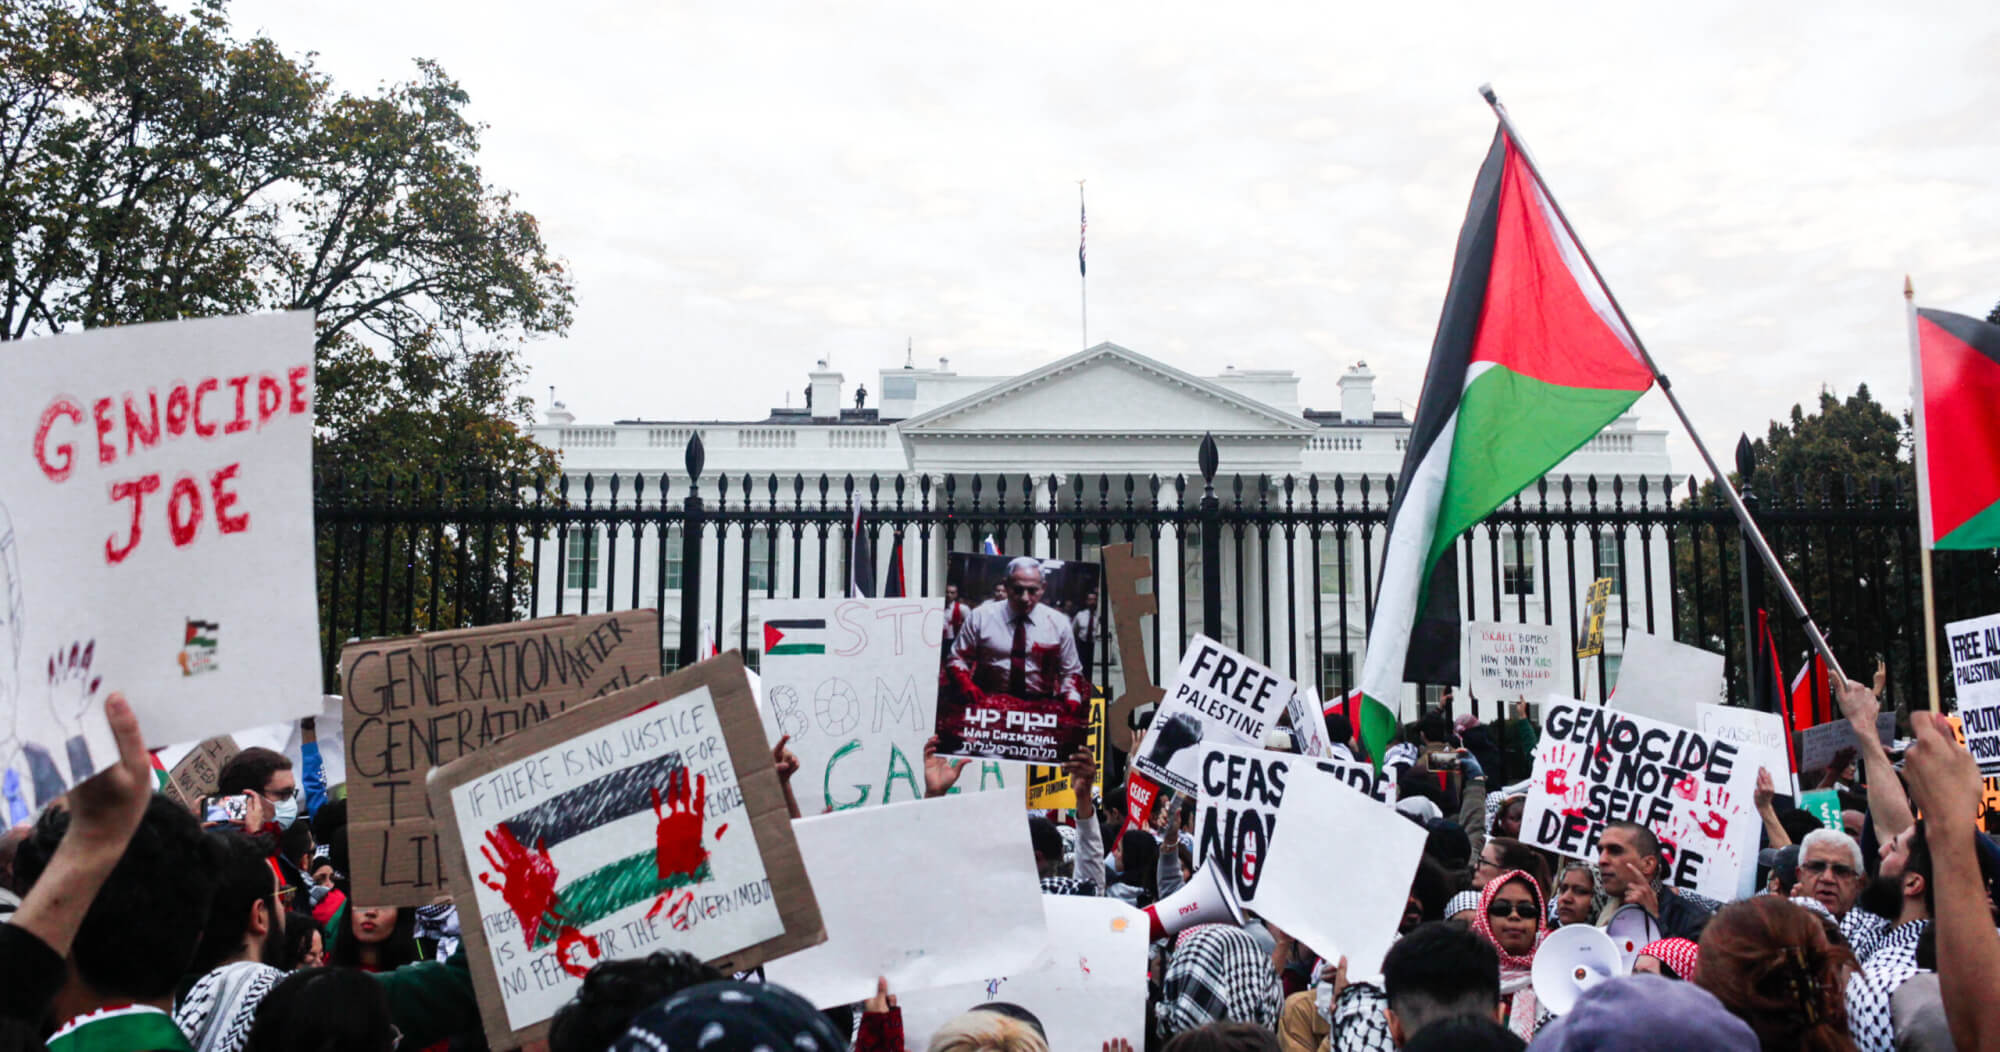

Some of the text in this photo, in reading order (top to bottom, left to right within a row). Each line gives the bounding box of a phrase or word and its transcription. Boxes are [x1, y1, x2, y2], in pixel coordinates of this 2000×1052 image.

[34, 366, 309, 482] GENOCIDE
[106, 463, 249, 564] JOE
[833, 601, 945, 657] STO
[1952, 631, 1983, 663] FREE
[348, 634, 567, 716] GENERATION
[566, 618, 632, 688] AFTER
[1189, 645, 1279, 714] FREE
[1481, 654, 1499, 665] HOW
[1504, 655, 1531, 666] MANY
[1176, 684, 1265, 740] PALESTINE
[468, 782, 486, 816] IF
[488, 757, 552, 810] THERE
[562, 750, 584, 776] IS
[586, 740, 613, 770] NO
[620, 704, 705, 758] JUSTICE
[685, 736, 722, 767] FOR
[1546, 705, 1739, 784] GENOCIDE
[1579, 743, 1688, 798] IS NOT
[1582, 785, 1673, 828] SELF
[496, 941, 515, 968] IS
[502, 967, 527, 1000] NO
[622, 914, 660, 949] THE
